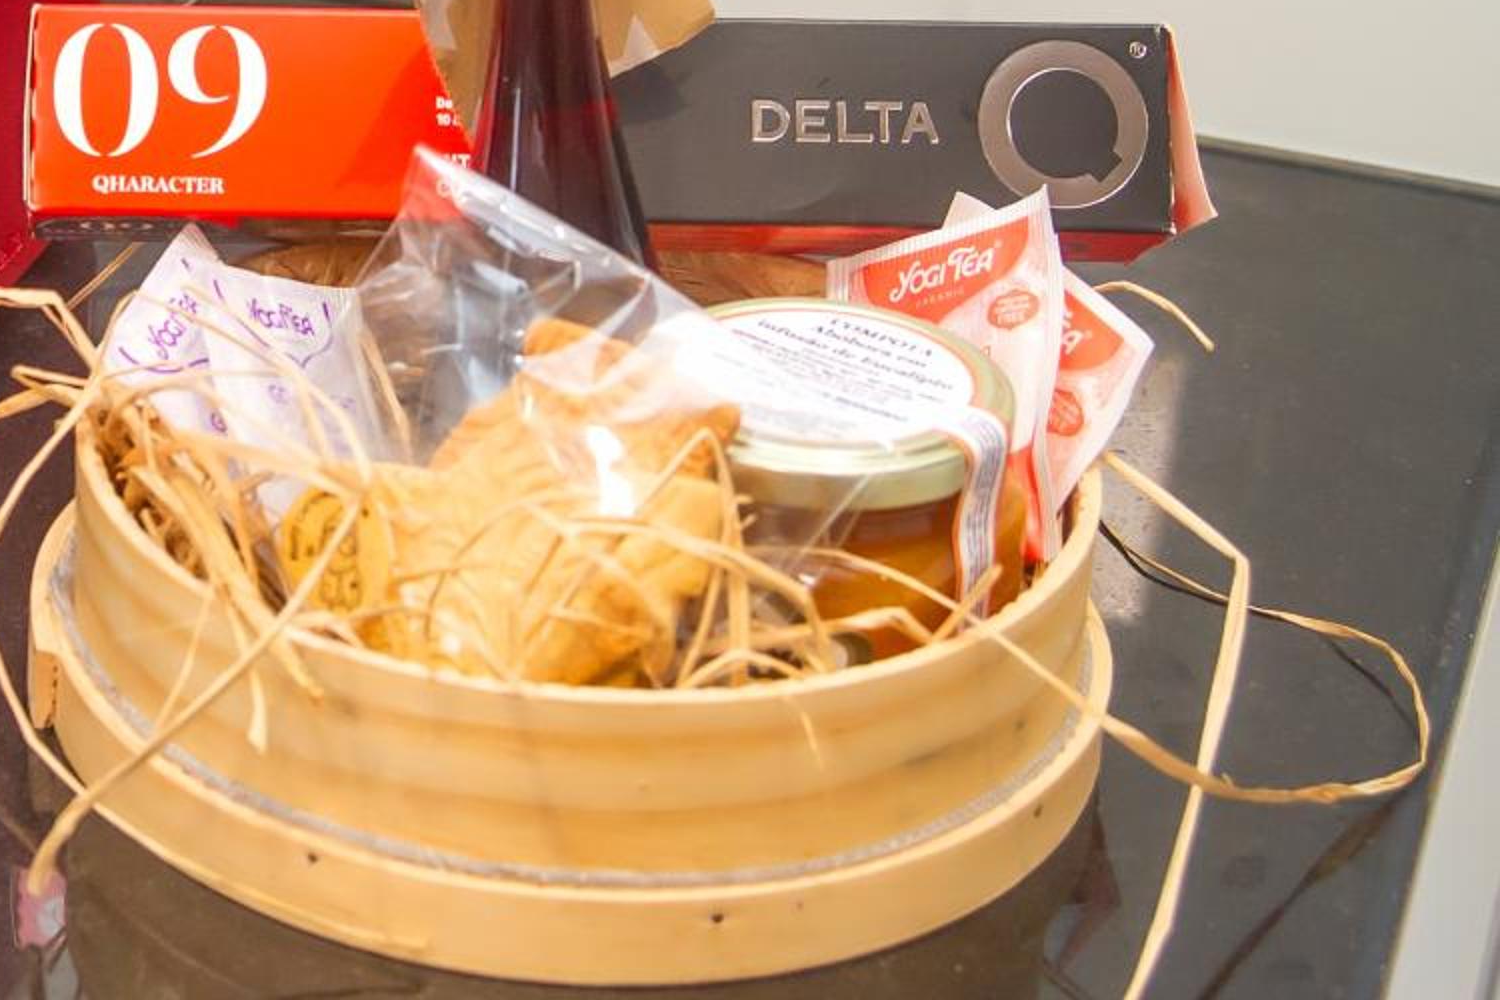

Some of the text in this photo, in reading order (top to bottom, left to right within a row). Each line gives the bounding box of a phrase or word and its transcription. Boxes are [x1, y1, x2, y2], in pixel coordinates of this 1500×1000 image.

[52, 22, 269, 160] 09
[750, 38, 1149, 210] DELTA Q
[91, 174, 227, 196] QHARACTER
